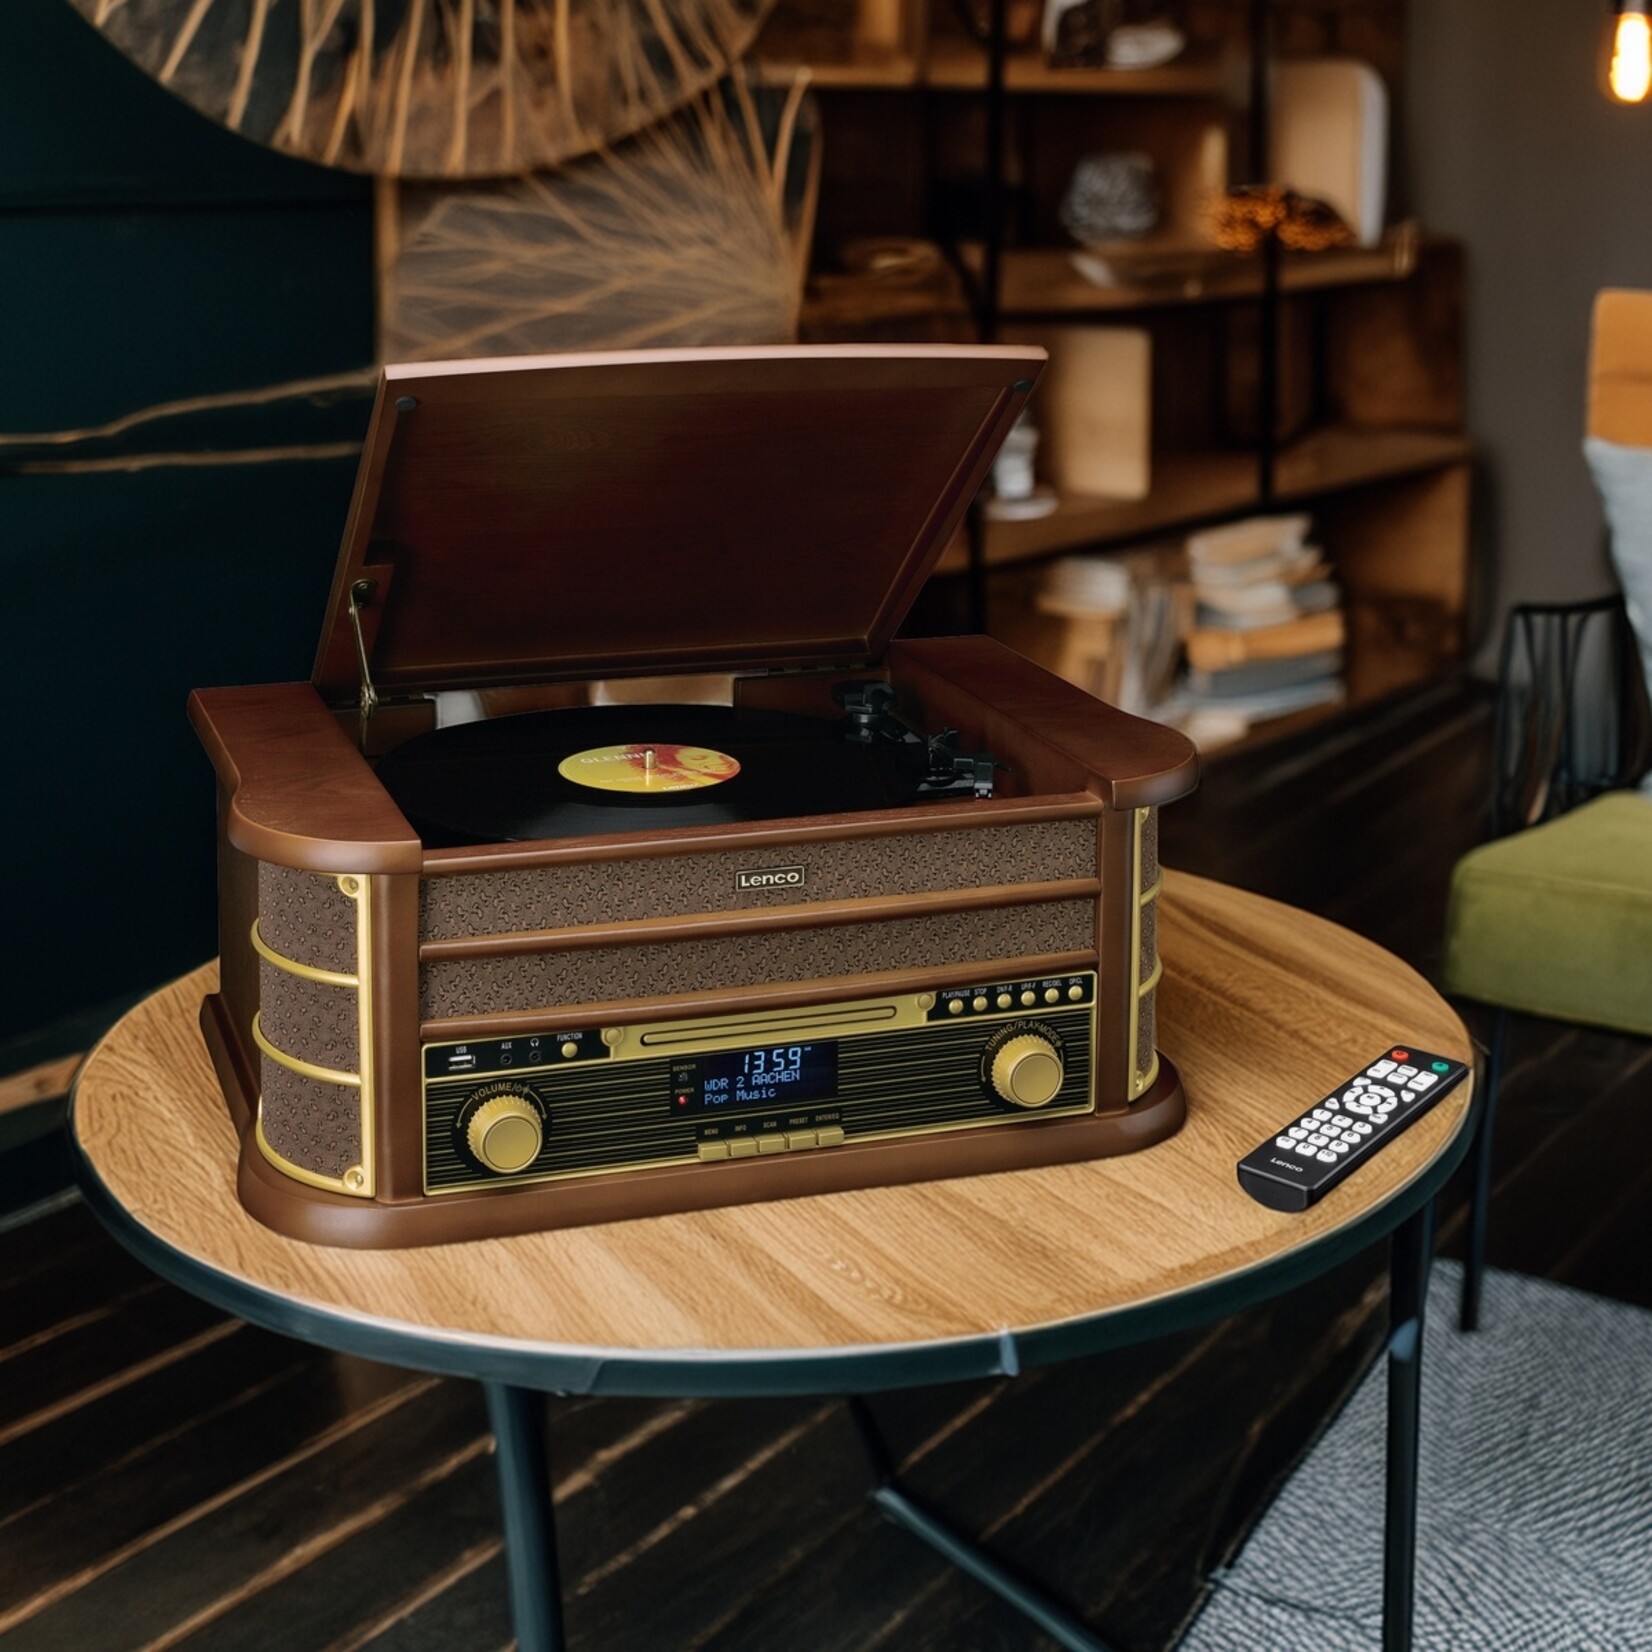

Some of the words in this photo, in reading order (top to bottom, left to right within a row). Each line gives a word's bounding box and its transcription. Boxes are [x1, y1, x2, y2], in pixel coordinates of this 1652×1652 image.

[741, 872, 800, 887] Lenco
[974, 987, 987, 996] STOP
[556, 1032, 583, 1042] FUNCTION
[455, 1045, 468, 1055] USB
[501, 1041, 513, 1050] AUX
[704, 1078, 729, 1092] WDR
[735, 1076, 745, 1088] 2
[752, 1070, 801, 1086] AACHEN
[704, 1094, 729, 1105] Pop
[736, 1088, 777, 1102] Music
[763, 1121, 777, 1129] SCAN
[1270, 1157, 1304, 1173] Lenco
